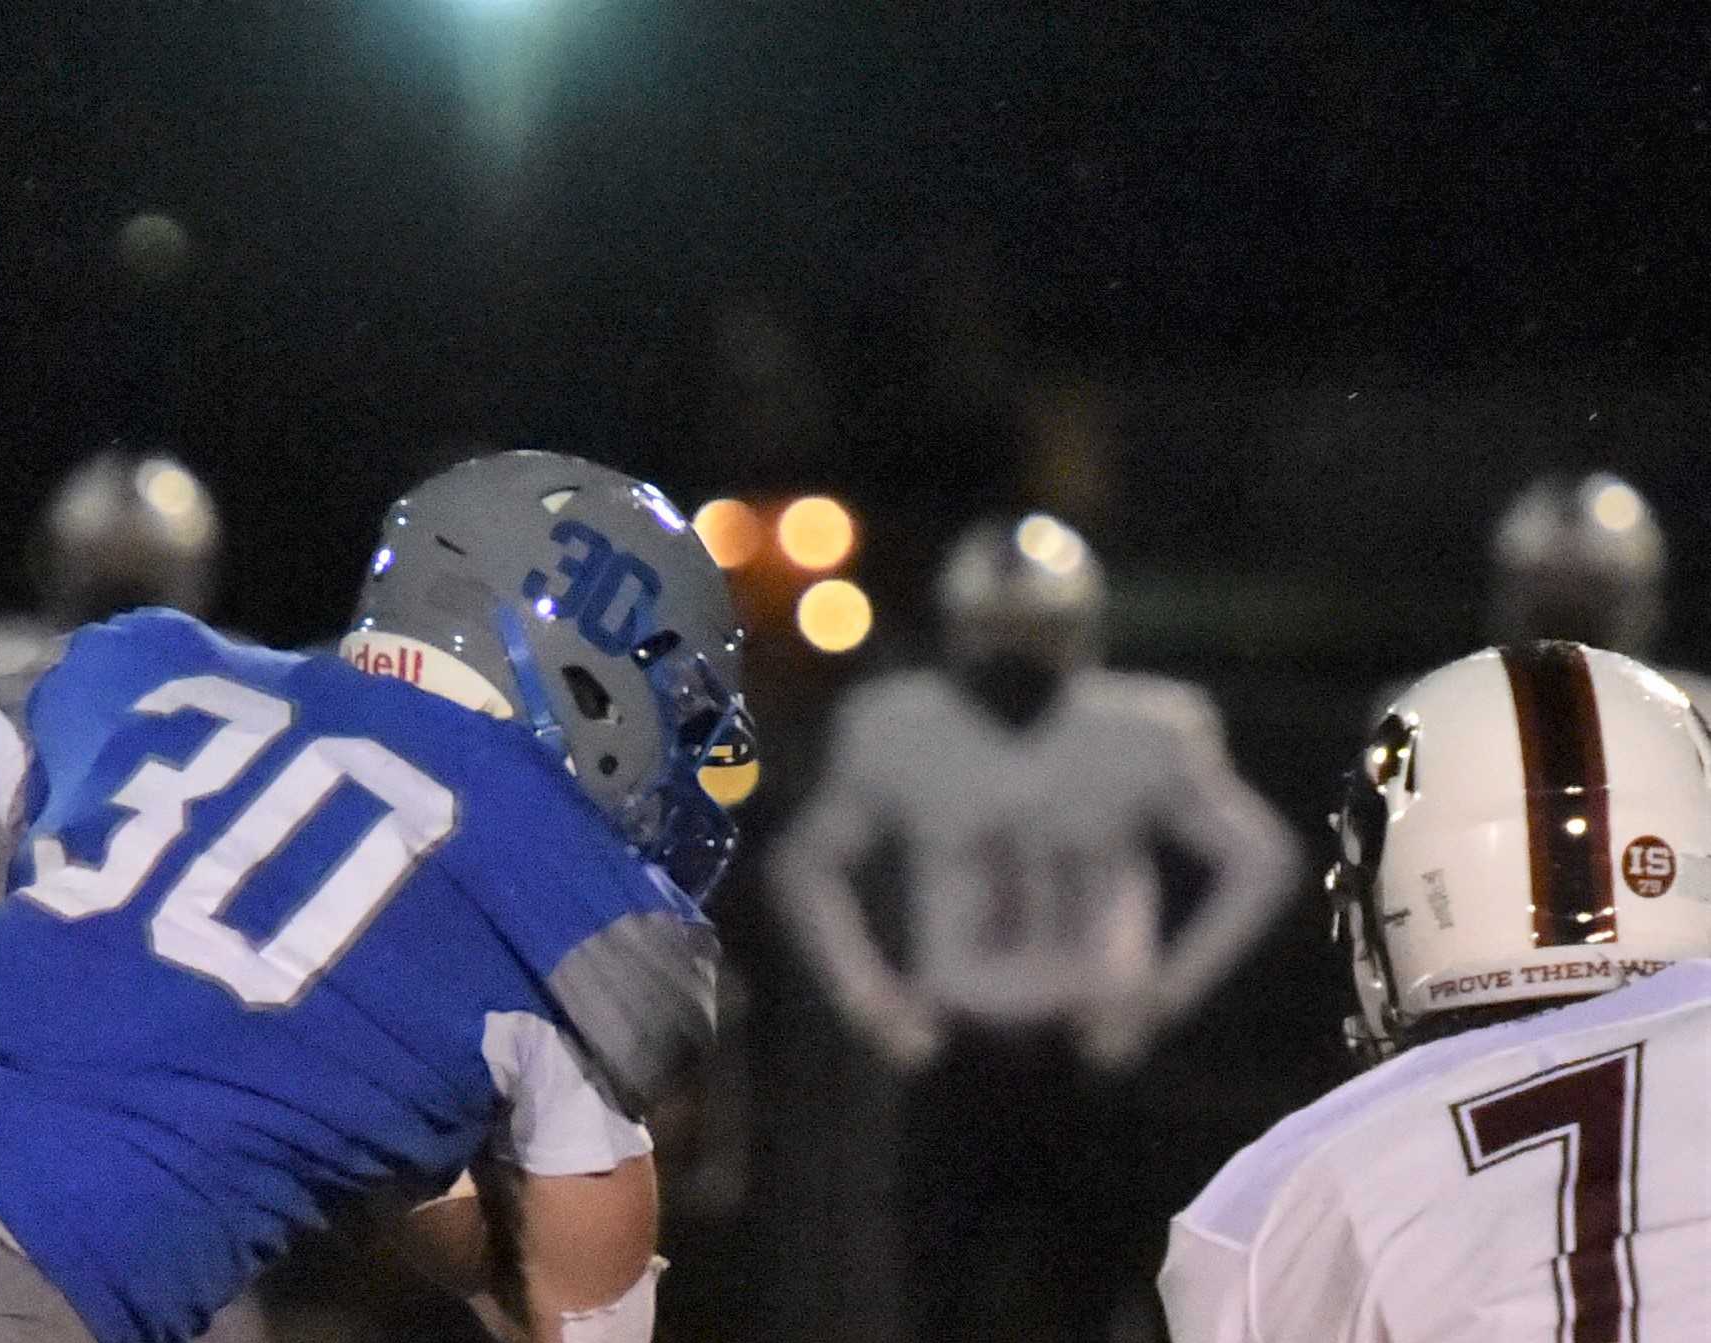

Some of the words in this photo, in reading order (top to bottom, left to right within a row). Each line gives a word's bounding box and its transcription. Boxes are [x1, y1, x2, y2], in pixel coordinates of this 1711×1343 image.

[522, 519, 662, 658] 30
[14, 676, 458, 1010] 30
[1429, 971, 1512, 1001] PROVE
[1521, 960, 1611, 984] THEM
